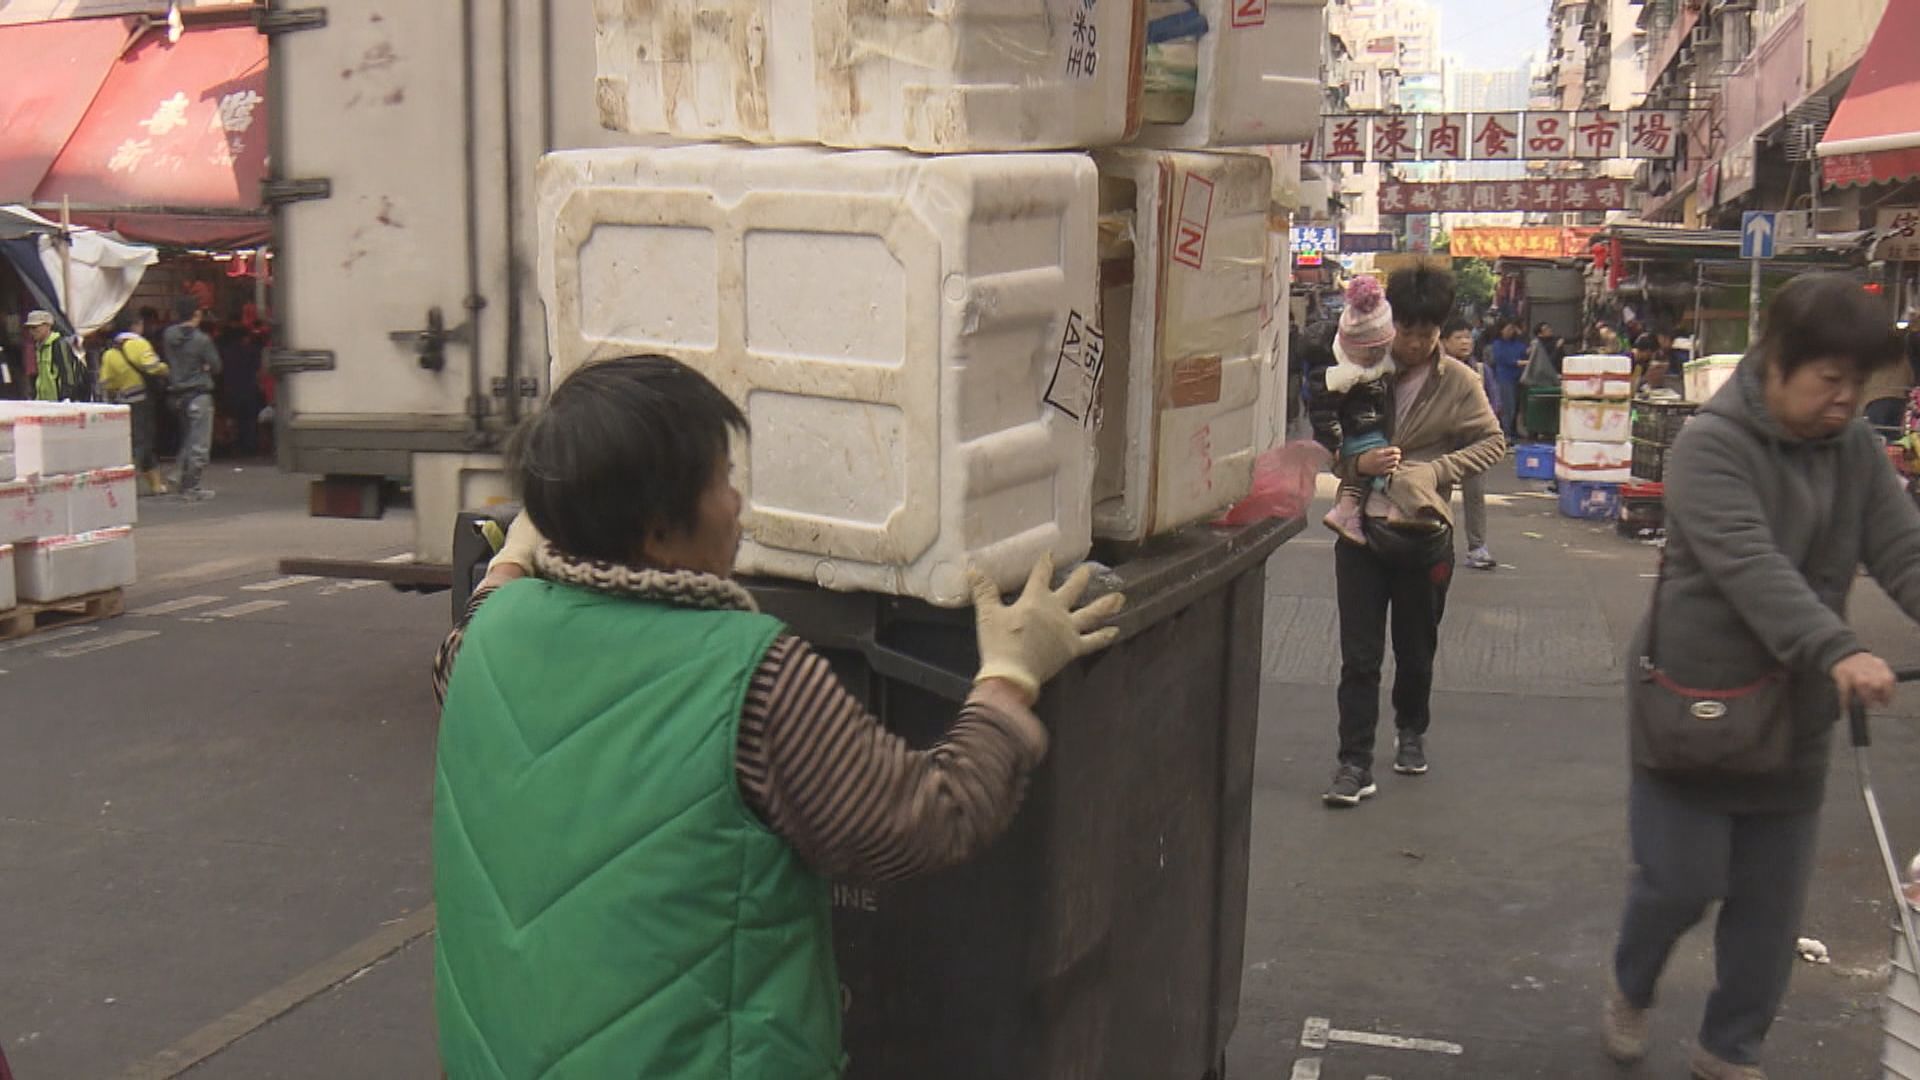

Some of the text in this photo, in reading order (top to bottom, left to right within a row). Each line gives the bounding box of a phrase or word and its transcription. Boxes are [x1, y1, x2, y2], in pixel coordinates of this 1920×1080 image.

[1300, 112, 1673, 160] 益凍肉食品市場
